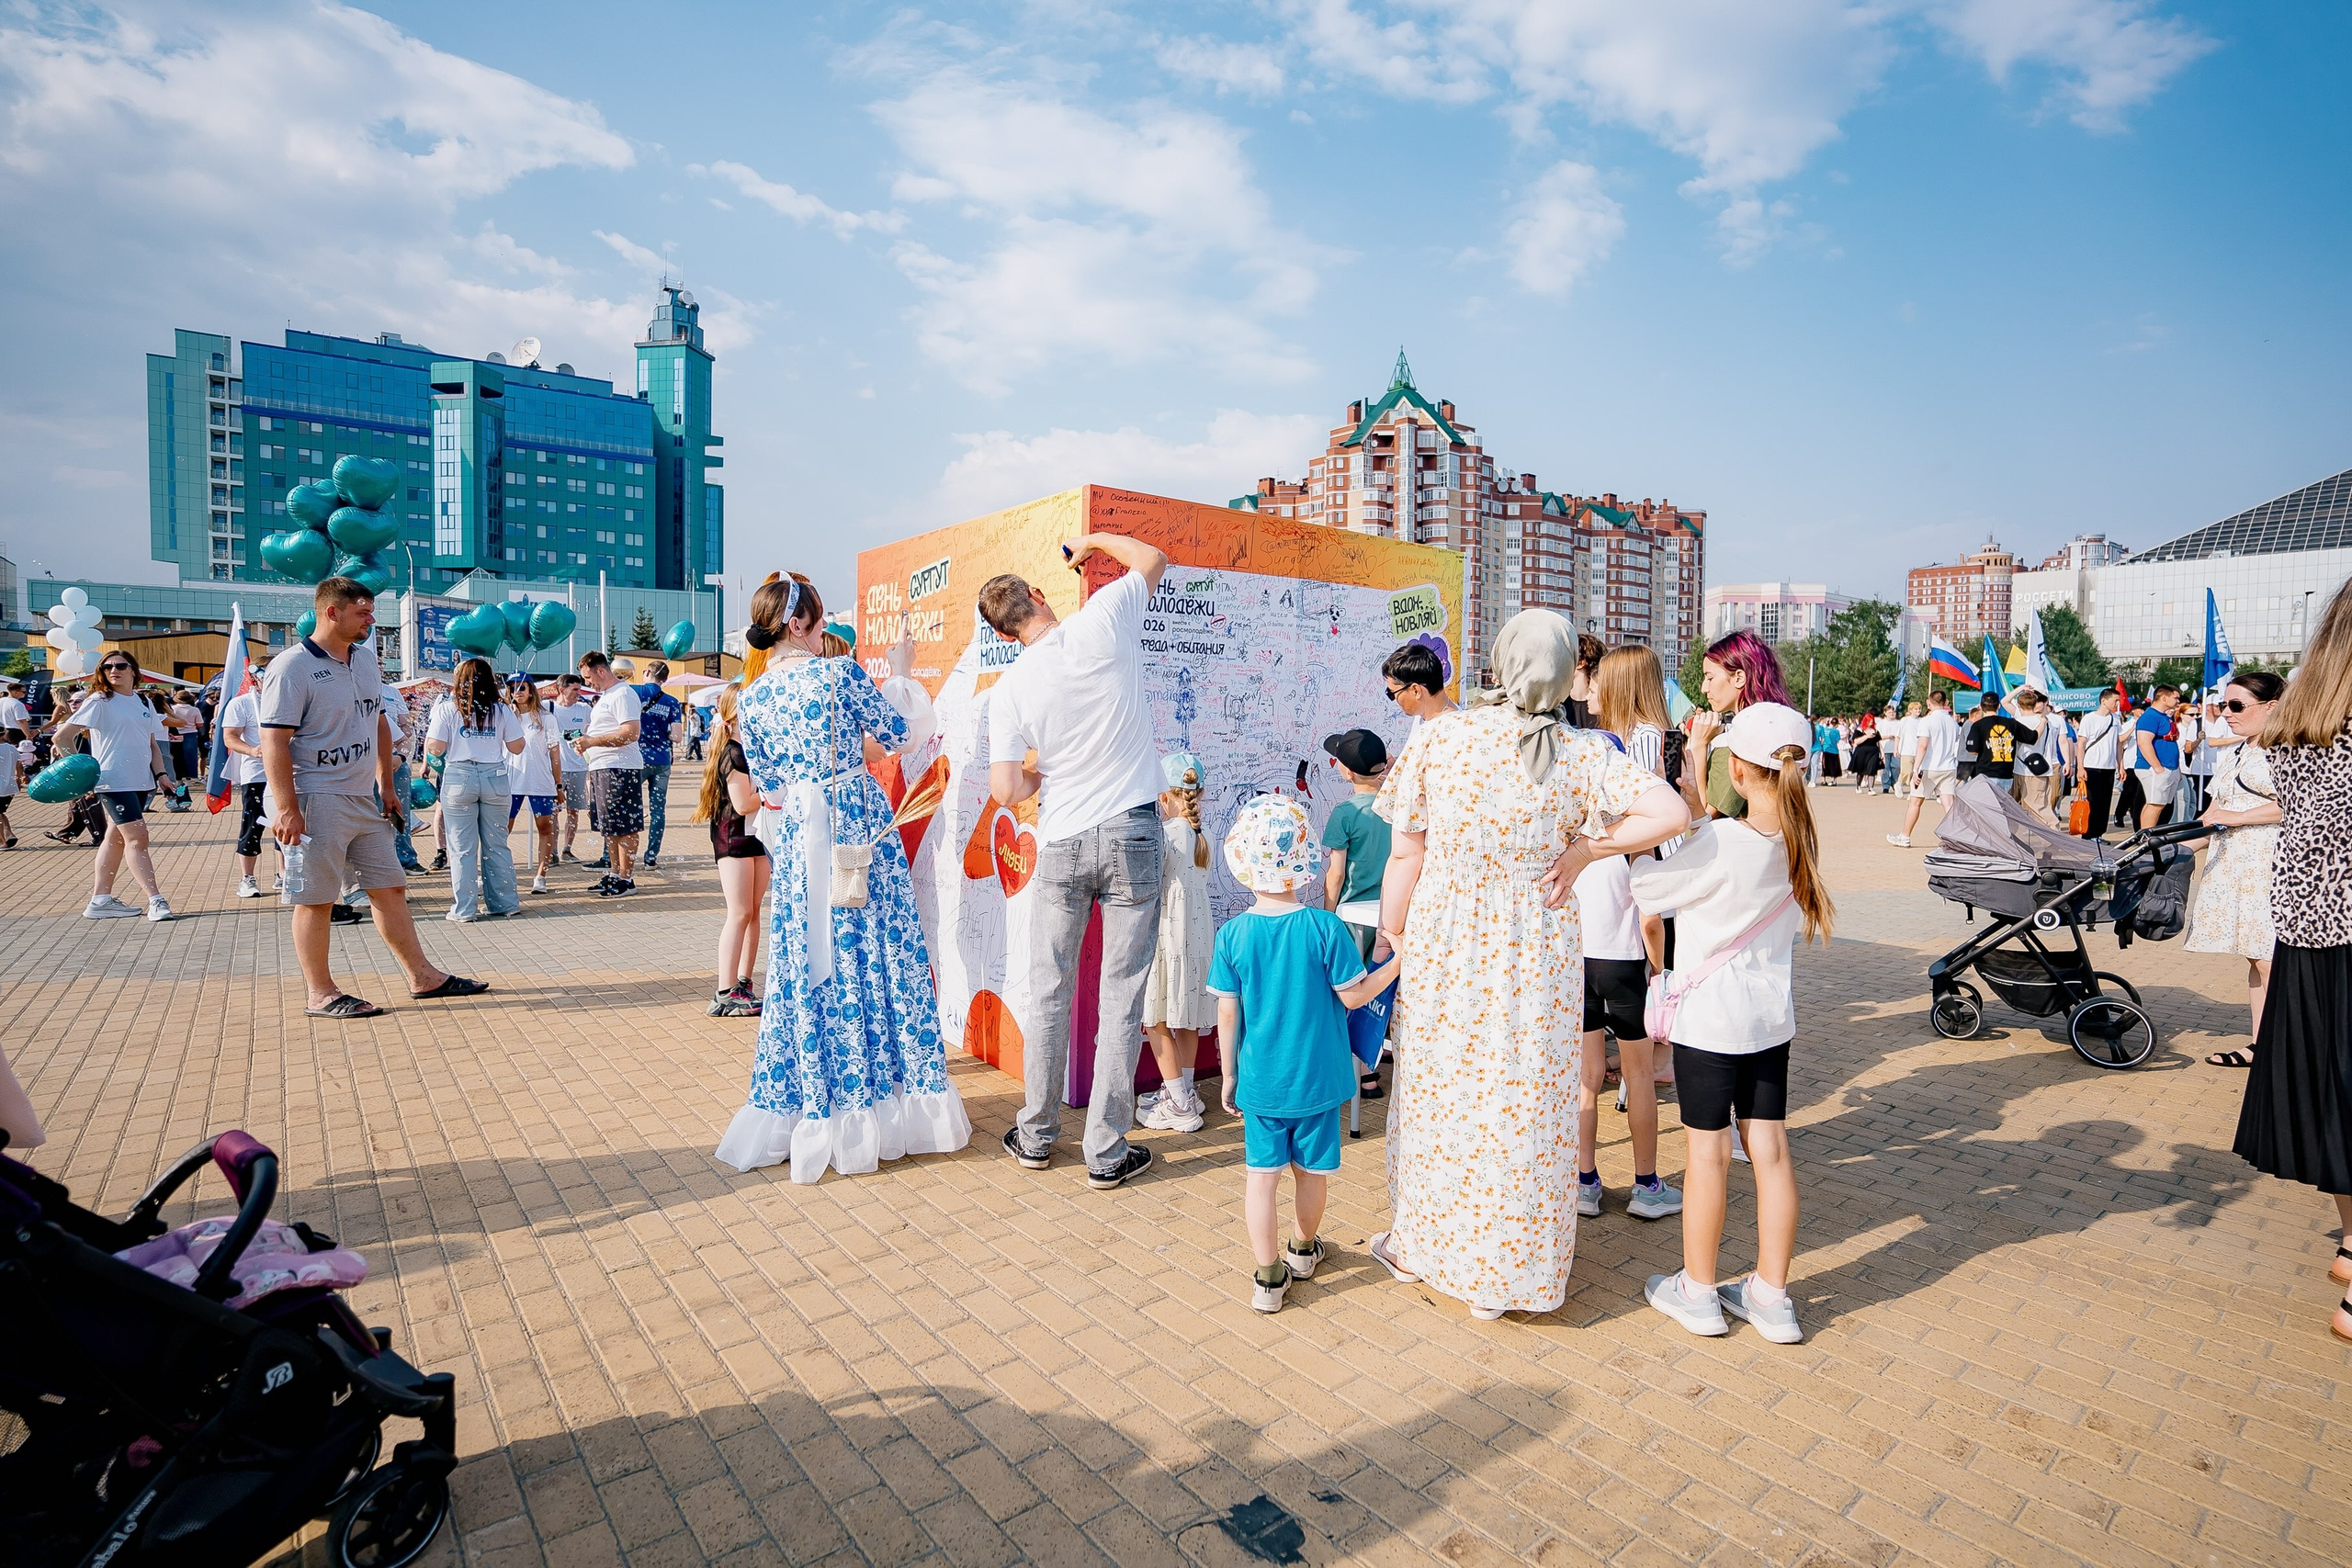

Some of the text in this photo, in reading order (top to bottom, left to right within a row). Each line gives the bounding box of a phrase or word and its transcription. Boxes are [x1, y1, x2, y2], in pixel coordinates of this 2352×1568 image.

[910, 559, 949, 600] СУРГУТ
[1185, 580, 1215, 592] СУРГУТ
[1146, 593, 1215, 616] ОЛОДЁЖИ
[2016, 590, 2074, 604] РОССЕТИ
[865, 605, 944, 647] МОЛОЁЖИ
[1143, 619, 1166, 632] 026
[1396, 606, 1438, 634] НОВЛЯЙ
[998, 842, 1028, 874] ЛЮБИ
